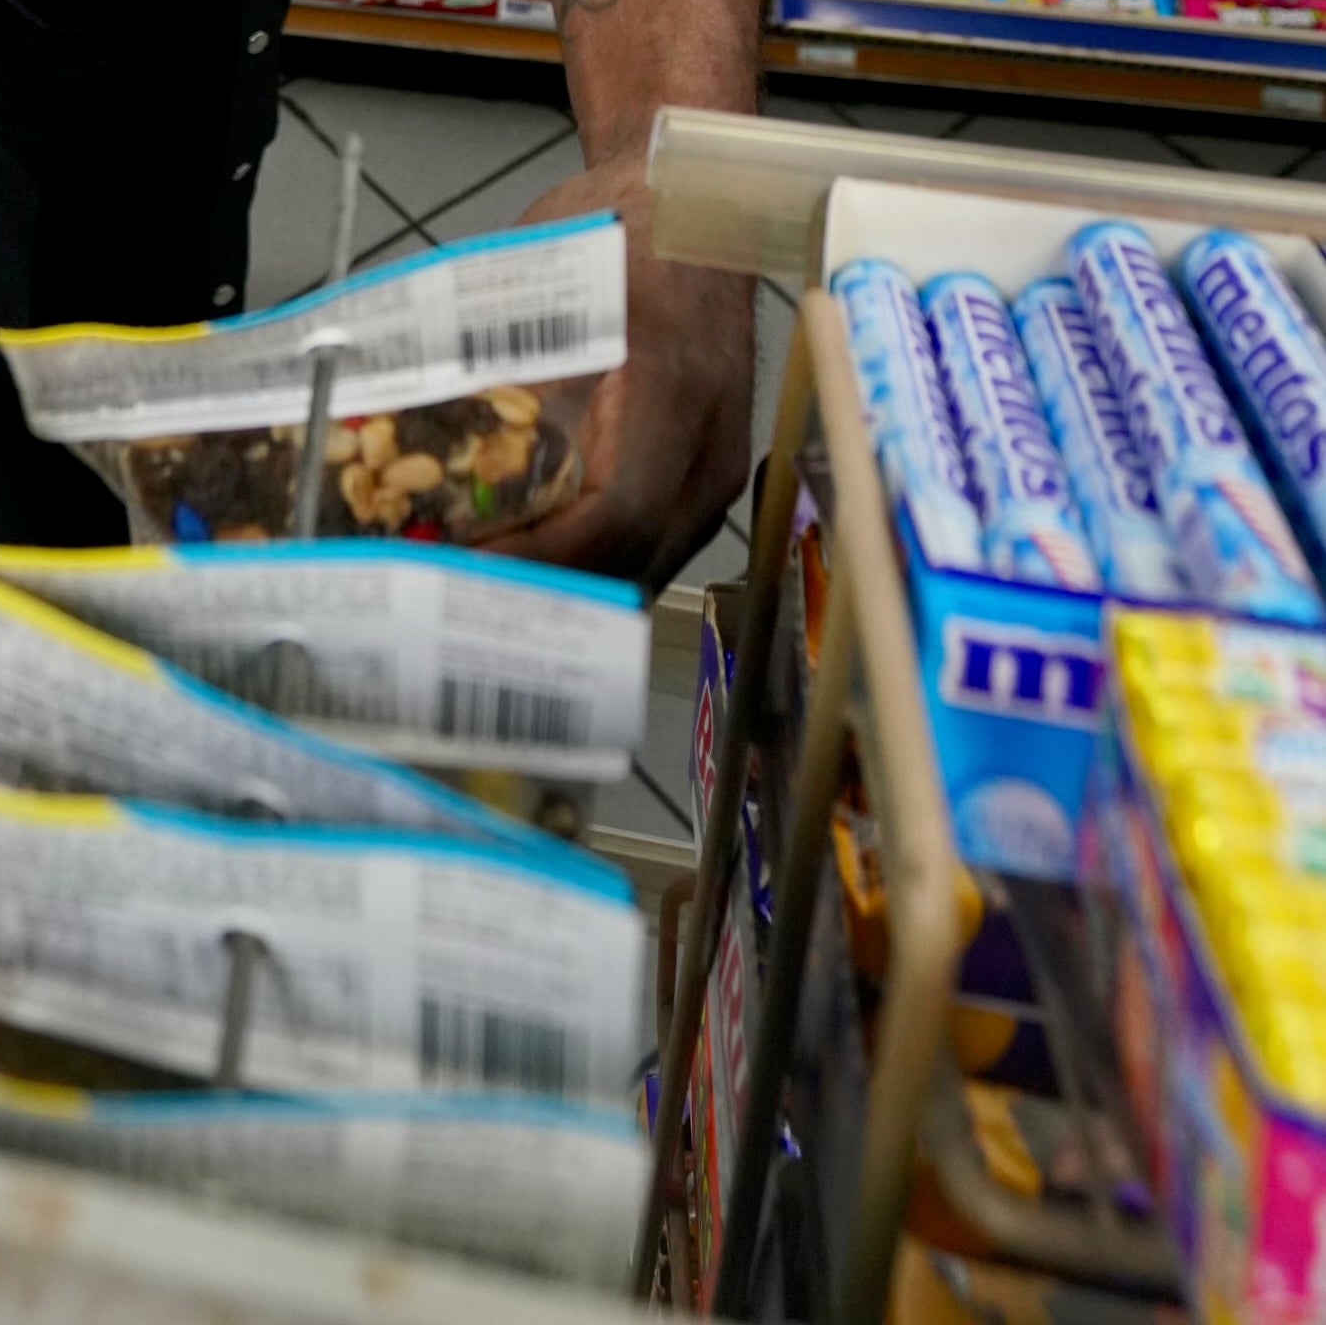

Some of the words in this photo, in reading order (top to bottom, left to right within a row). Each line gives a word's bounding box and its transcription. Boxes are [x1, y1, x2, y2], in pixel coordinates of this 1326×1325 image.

[964, 292, 1061, 500] mentos
[1122, 242, 1238, 447] mentos
[1196, 257, 1326, 483] mentos
